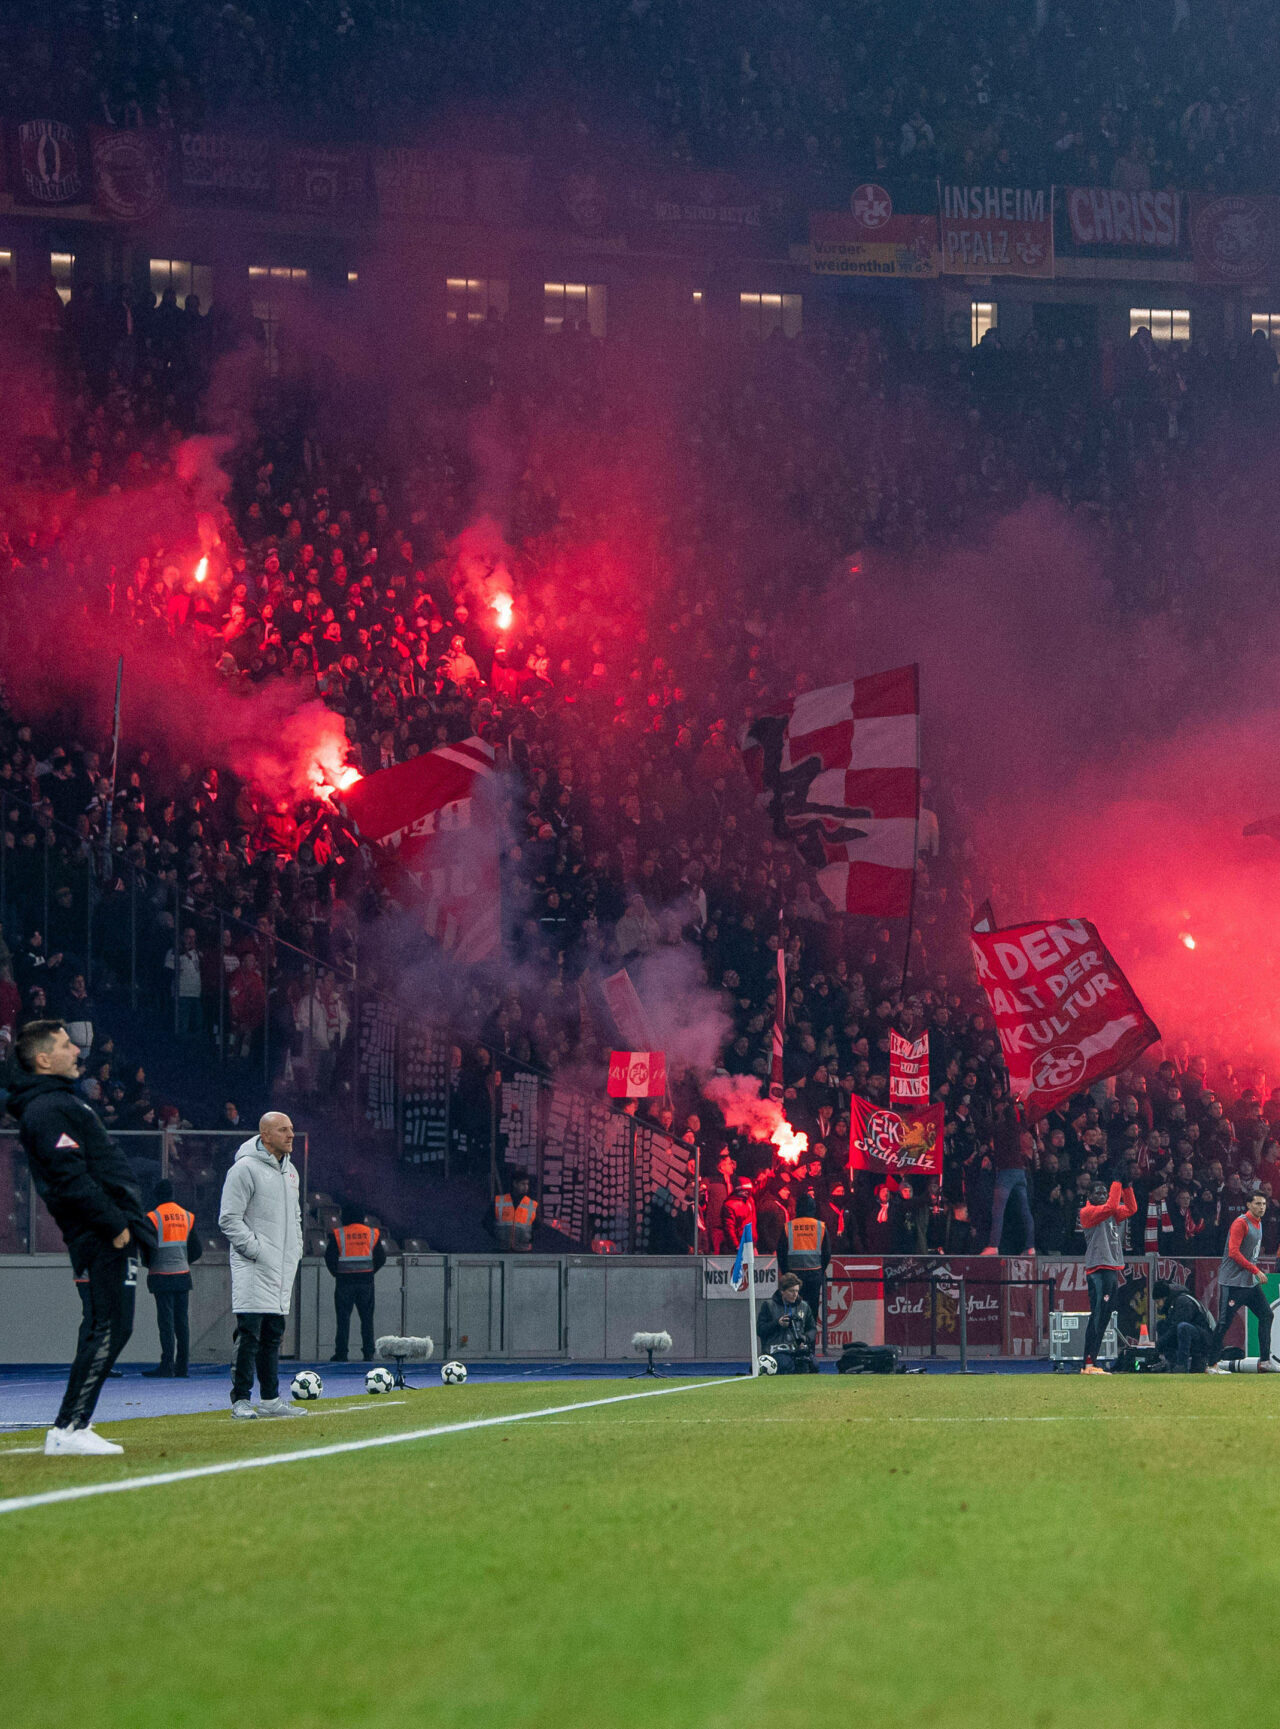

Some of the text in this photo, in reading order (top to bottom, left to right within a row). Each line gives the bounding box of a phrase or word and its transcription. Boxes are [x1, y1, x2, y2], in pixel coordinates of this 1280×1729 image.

[943, 185, 1045, 222] INSHEIM
[1070, 189, 1181, 246] CHRISSI
[947, 231, 1012, 265] PFALZ
[814, 258, 895, 273] weidenthal
[993, 919, 1091, 981] DEN
[1044, 950, 1103, 998] DER
[985, 985, 1045, 1015] ALT
[890, 1077, 929, 1095] JUNGS
[854, 1137, 936, 1168] Südpfalz
[164, 1214, 185, 1222] BEST
[347, 1232, 368, 1240] BEST
[705, 1268, 776, 1285] WEST BOYS
[888, 1296, 924, 1314] Süd
